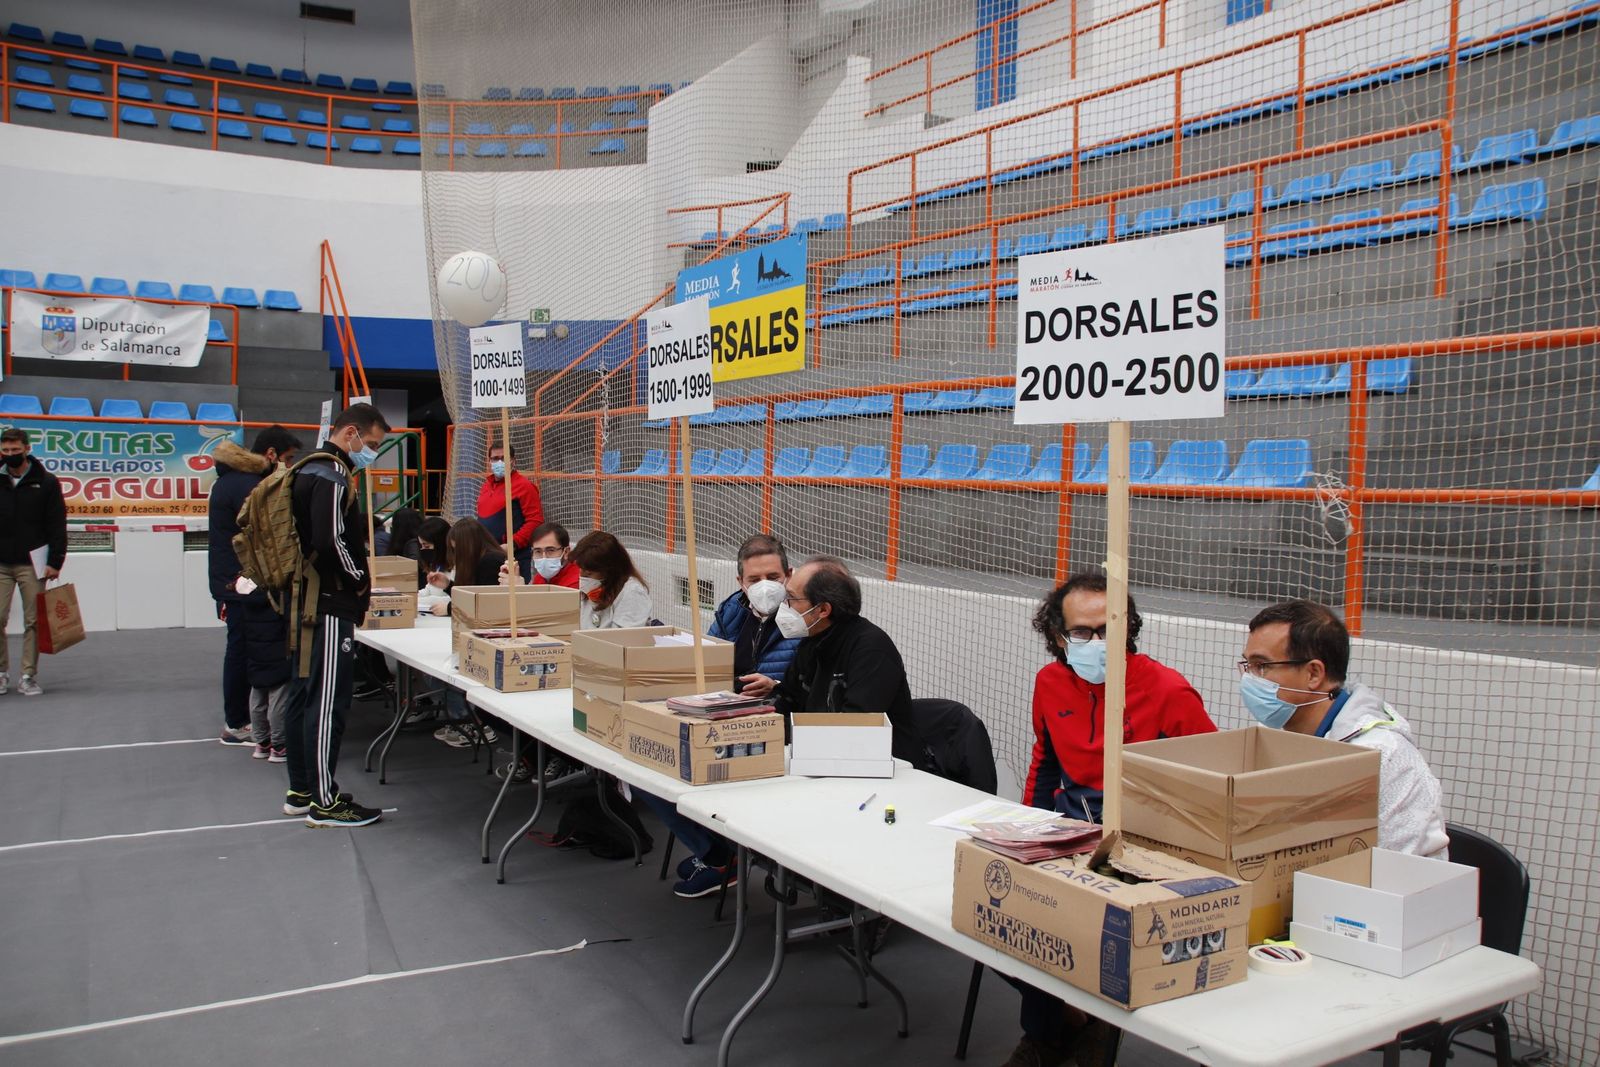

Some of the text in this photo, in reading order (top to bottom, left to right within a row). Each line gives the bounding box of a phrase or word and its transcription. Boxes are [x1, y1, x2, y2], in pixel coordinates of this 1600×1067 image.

[685, 275, 720, 295] MEDIA
[1030, 275, 1059, 287] MEDIA
[1030, 284, 1060, 292] MARATÓN
[82, 317, 166, 334] Diputación
[1025, 289, 1218, 344] DORSALES
[81, 338, 181, 355] de Salamanca
[650, 333, 709, 368] DORSALES
[473, 350, 523, 370] DORSALES
[1019, 352, 1220, 401] 2000-2500
[473, 377, 525, 397] 1000-1499
[650, 372, 712, 404] 1500-1999
[42, 458, 165, 473] ONGELADOS
[78, 506, 88, 514] 12
[90, 506, 101, 514] 37
[103, 506, 113, 514] 60
[170, 505, 180, 514] 25
[192, 505, 207, 514] 923
[722, 719, 776, 731] MONDARIZ
[985, 861, 1011, 890] MONDARIZ
[1013, 881, 1058, 909] Inmejorable
[1170, 895, 1240, 919] MONDARIZ
[975, 903, 991, 921] LA
[990, 908, 1035, 940] MEJOR
[1034, 928, 1074, 958] AGUA
[975, 917, 1008, 942] DEL
[1006, 929, 1075, 972] MUNDO
